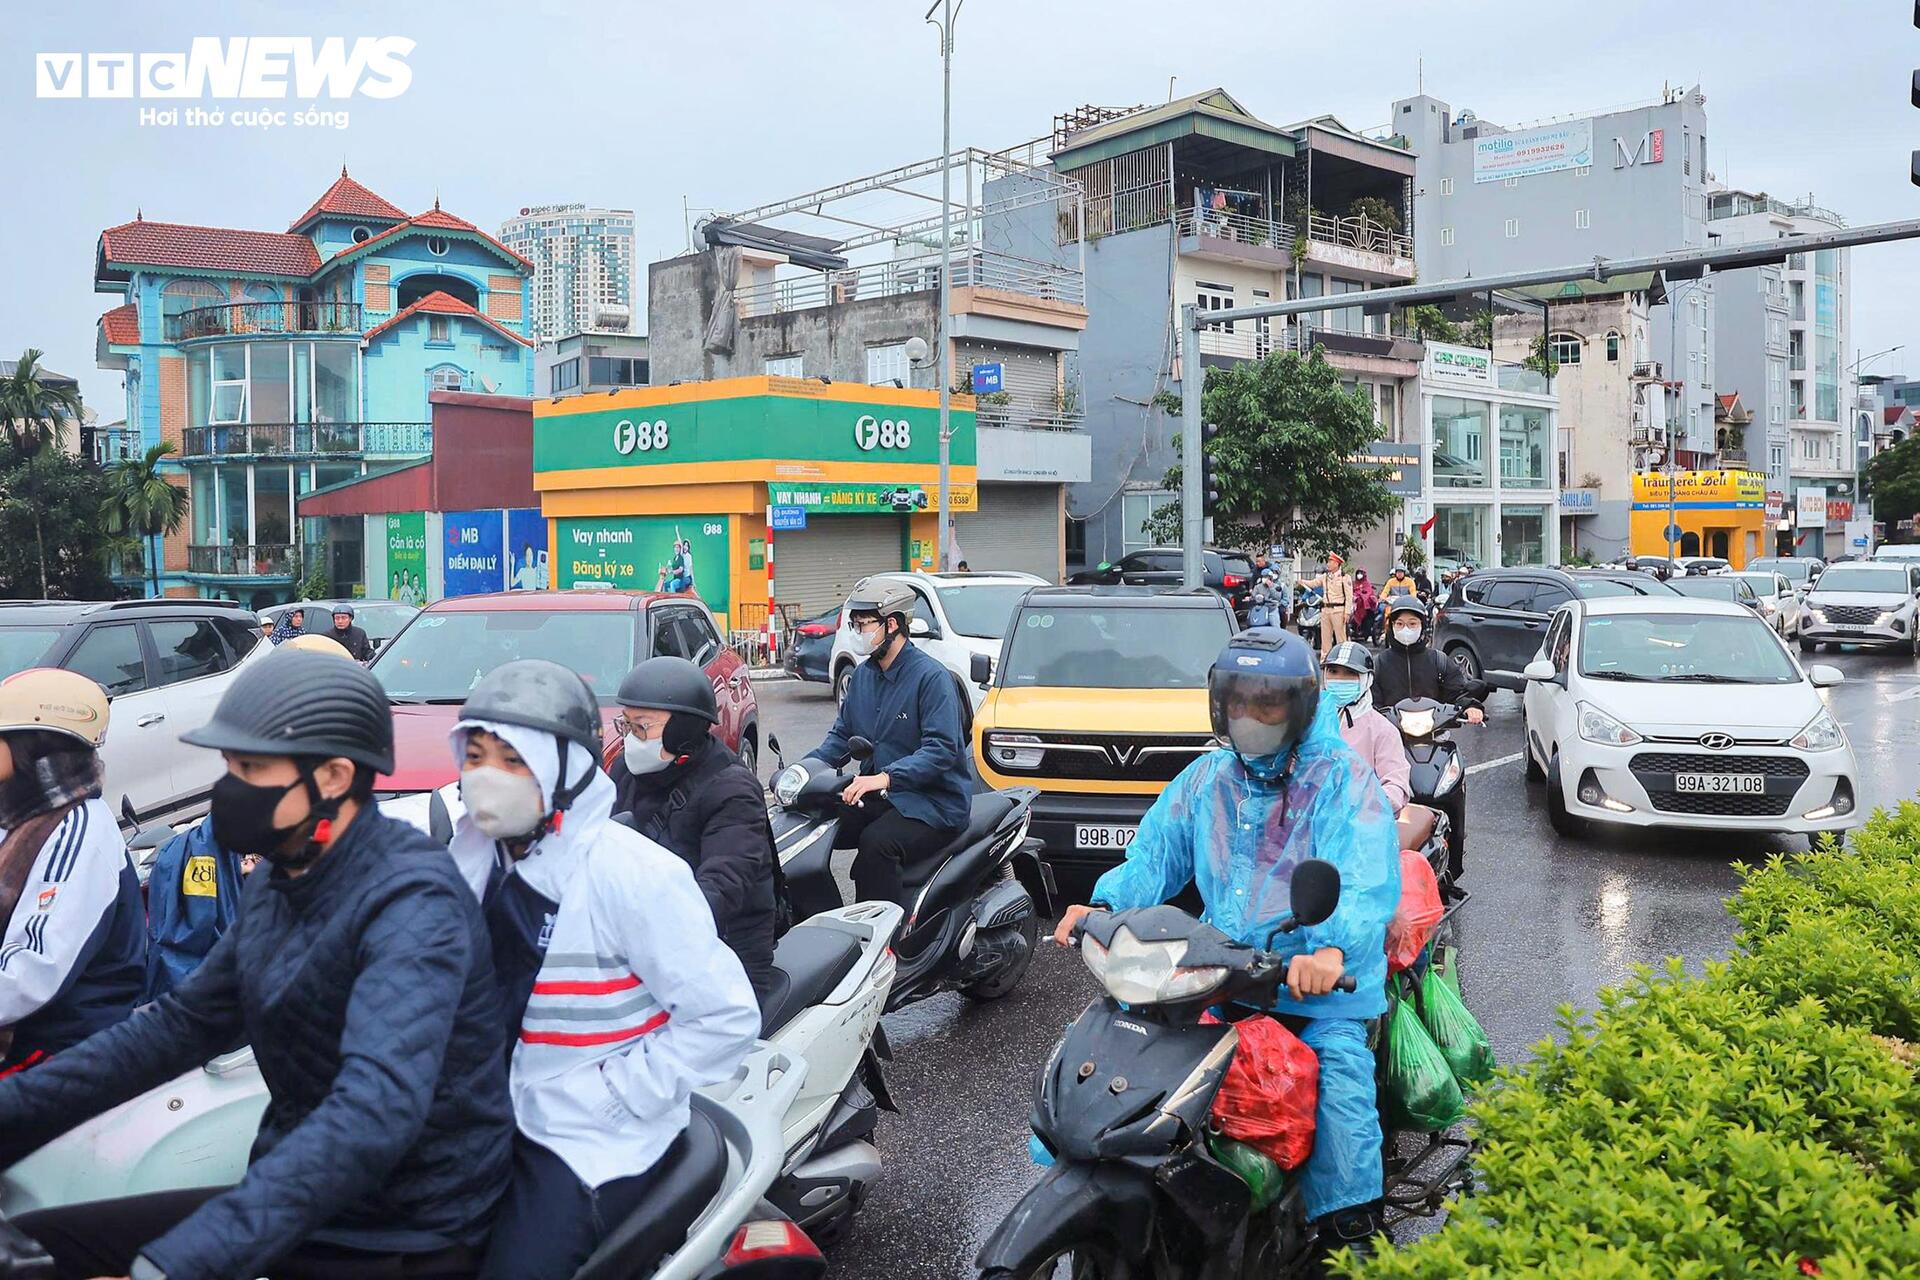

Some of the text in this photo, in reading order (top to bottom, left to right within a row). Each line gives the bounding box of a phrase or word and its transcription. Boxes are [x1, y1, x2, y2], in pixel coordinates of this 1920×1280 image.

[1612, 130, 1655, 170] M
[985, 375, 998, 385] MB
[613, 419, 668, 455] F88
[855, 414, 911, 450] F88
[1701, 475, 1727, 487] Deli
[776, 491, 792, 505] VAY
[793, 492, 821, 505] NHANH
[831, 490, 853, 505] ĐĂNG
[855, 489, 865, 505] KÝ
[866, 492, 877, 505] XE
[461, 528, 478, 544] MB
[572, 528, 633, 546] Vay nhanh
[703, 522, 723, 535] F88
[406, 533, 414, 549] là
[414, 533, 425, 549] có
[470, 557, 486, 573] ĐẠI
[487, 554, 497, 570] LÝ
[573, 560, 634, 578] Đăng ký xe
[1677, 775, 1763, 793] 99A-321.08
